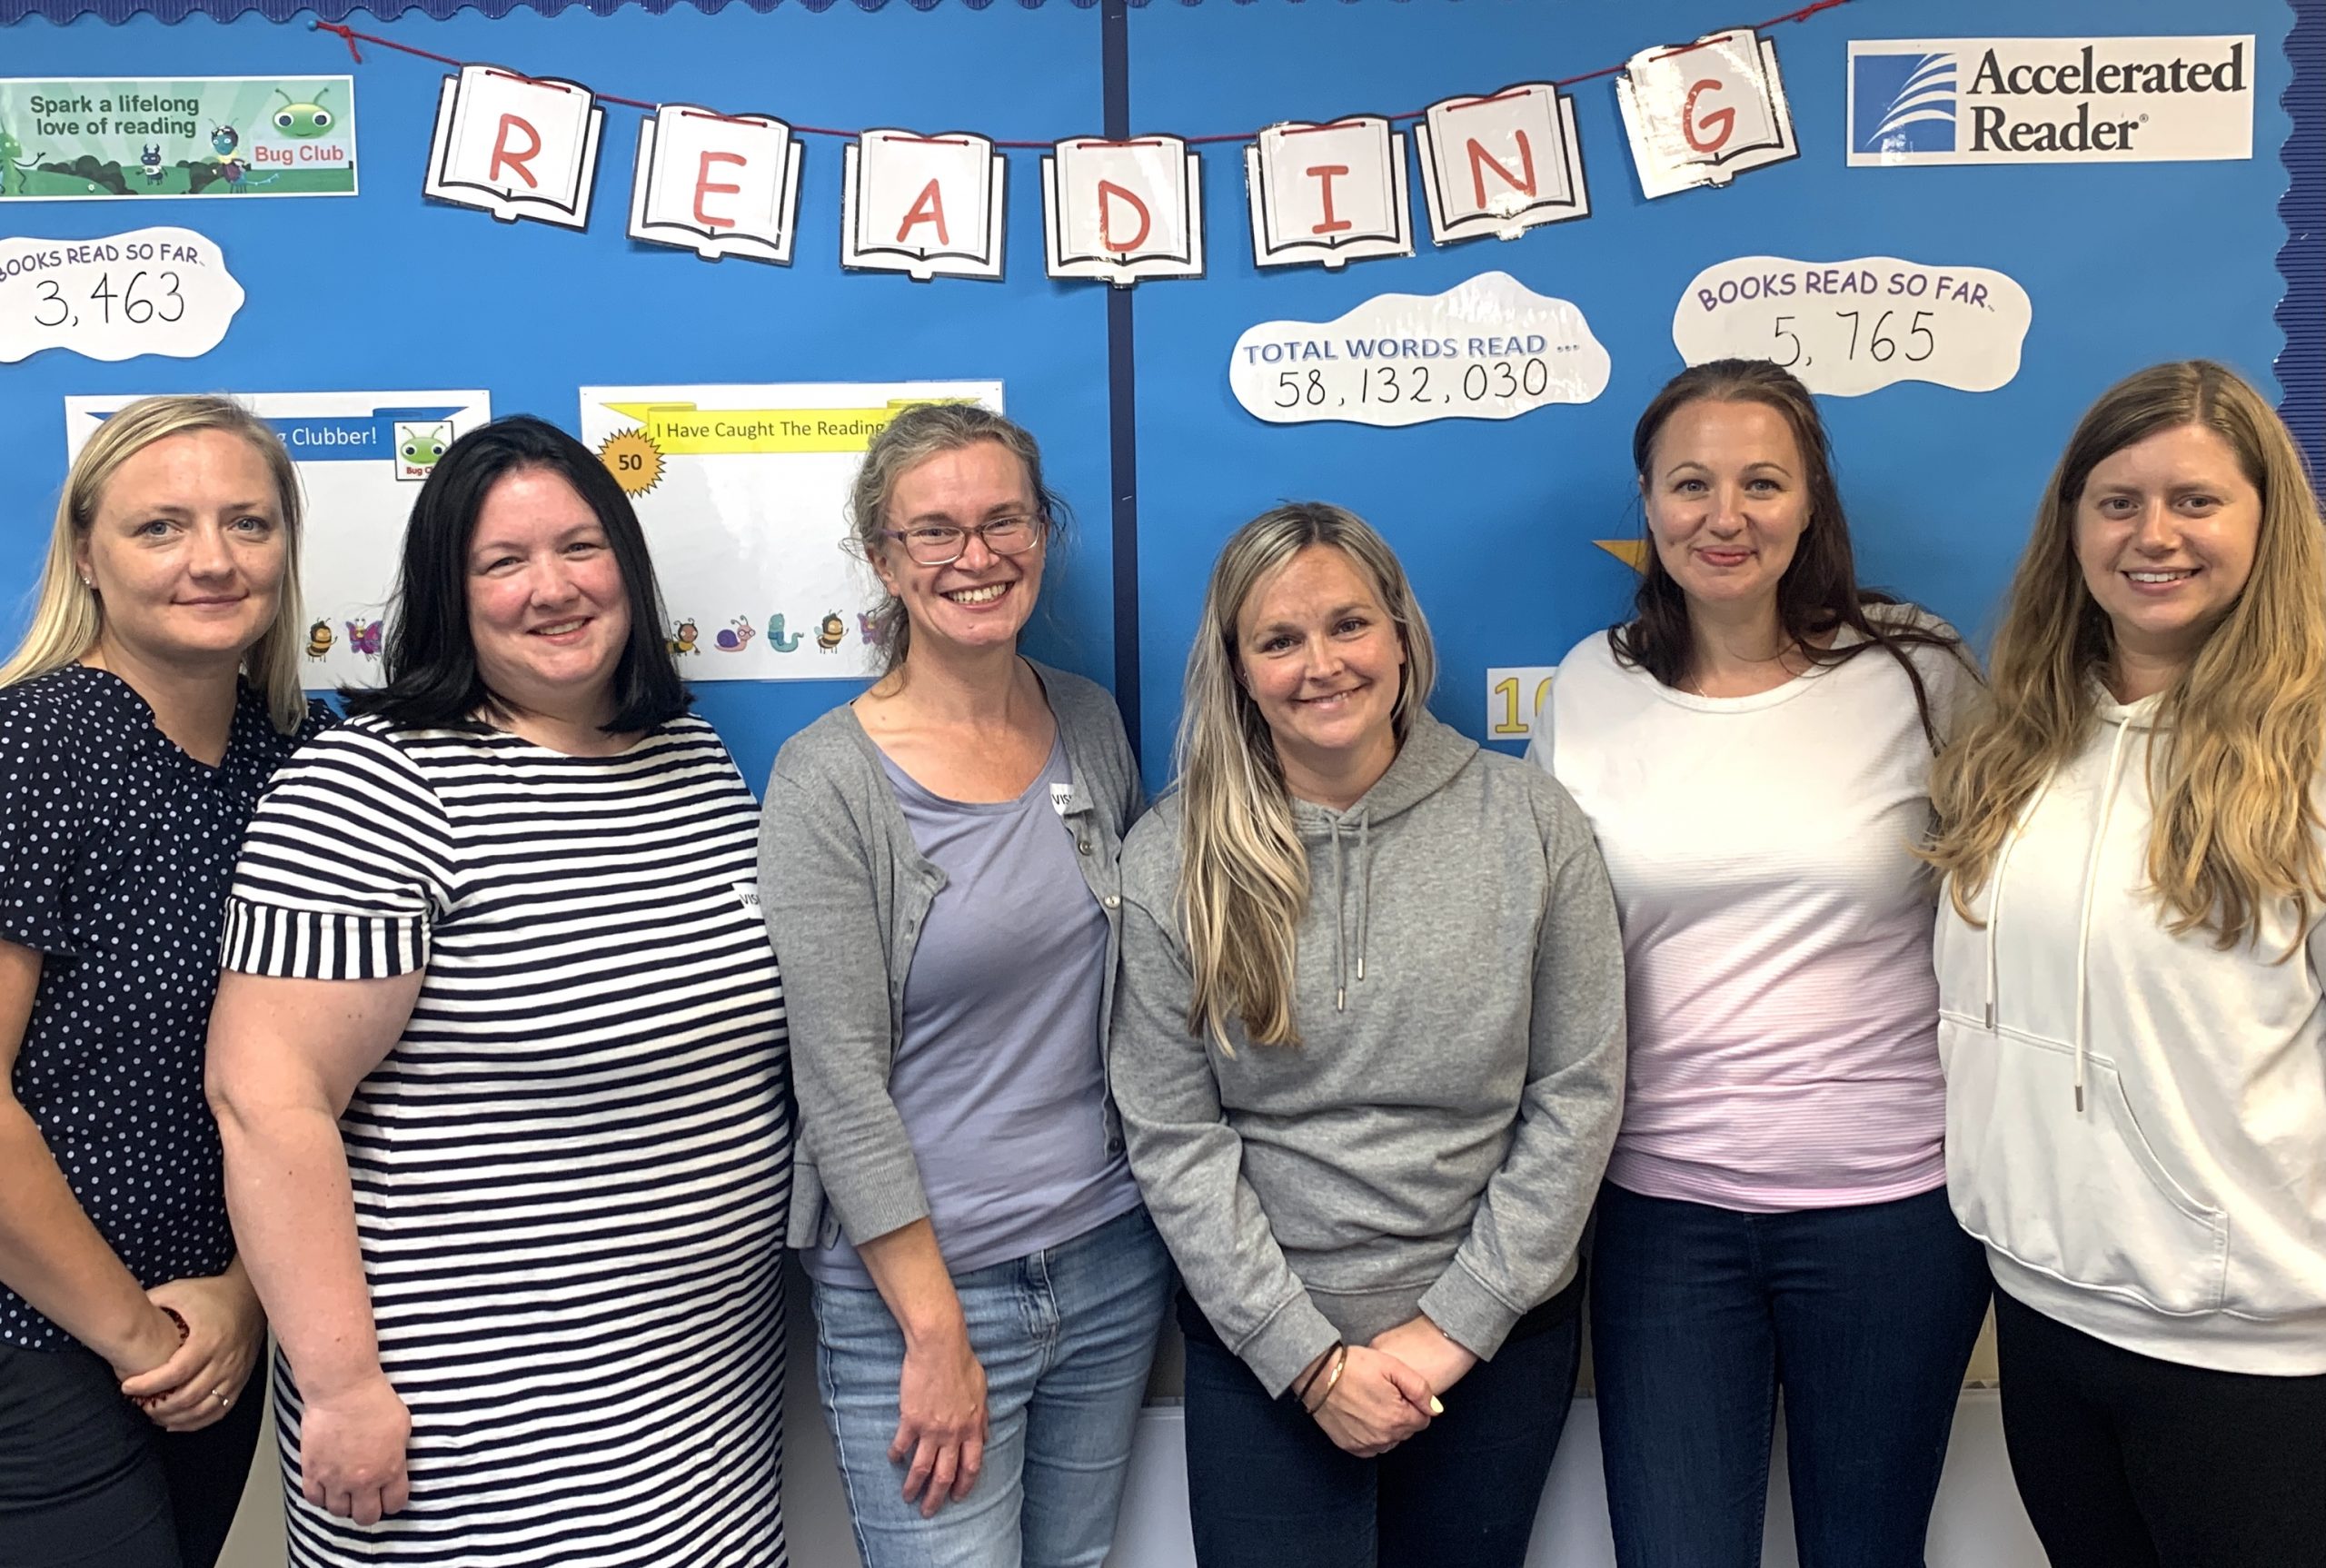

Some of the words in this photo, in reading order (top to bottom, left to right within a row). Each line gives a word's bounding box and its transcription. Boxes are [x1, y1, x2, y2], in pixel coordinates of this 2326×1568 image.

[1966, 42, 2247, 94] Accelerated
[30, 95, 93, 116] Spark
[100, 98, 112, 112] a
[119, 94, 199, 116] lifelong
[37, 118, 79, 135] love
[86, 118, 108, 134] of
[114, 117, 196, 138] reading
[255, 146, 293, 165] Bug
[300, 145, 343, 162] Club
[67, 244, 119, 264] READ
[126, 243, 154, 260] SO
[35, 272, 184, 326] 3,463
[1698, 273, 1796, 312] BOOKS
[1806, 270, 1878, 294] READ
[1887, 273, 1927, 297] SO
[1243, 340, 1338, 364] TOTAL
[1346, 337, 1458, 360] WORDS
[1468, 334, 1547, 357] READ
[292, 426, 377, 446] Clubber!
[657, 423, 661, 438] I
[667, 423, 710, 438] Have
[715, 422, 775, 440] Caught
[780, 421, 811, 436] The
[818, 420, 885, 437] Reading
[406, 466, 422, 476] Bug
[619, 454, 642, 471] 50
